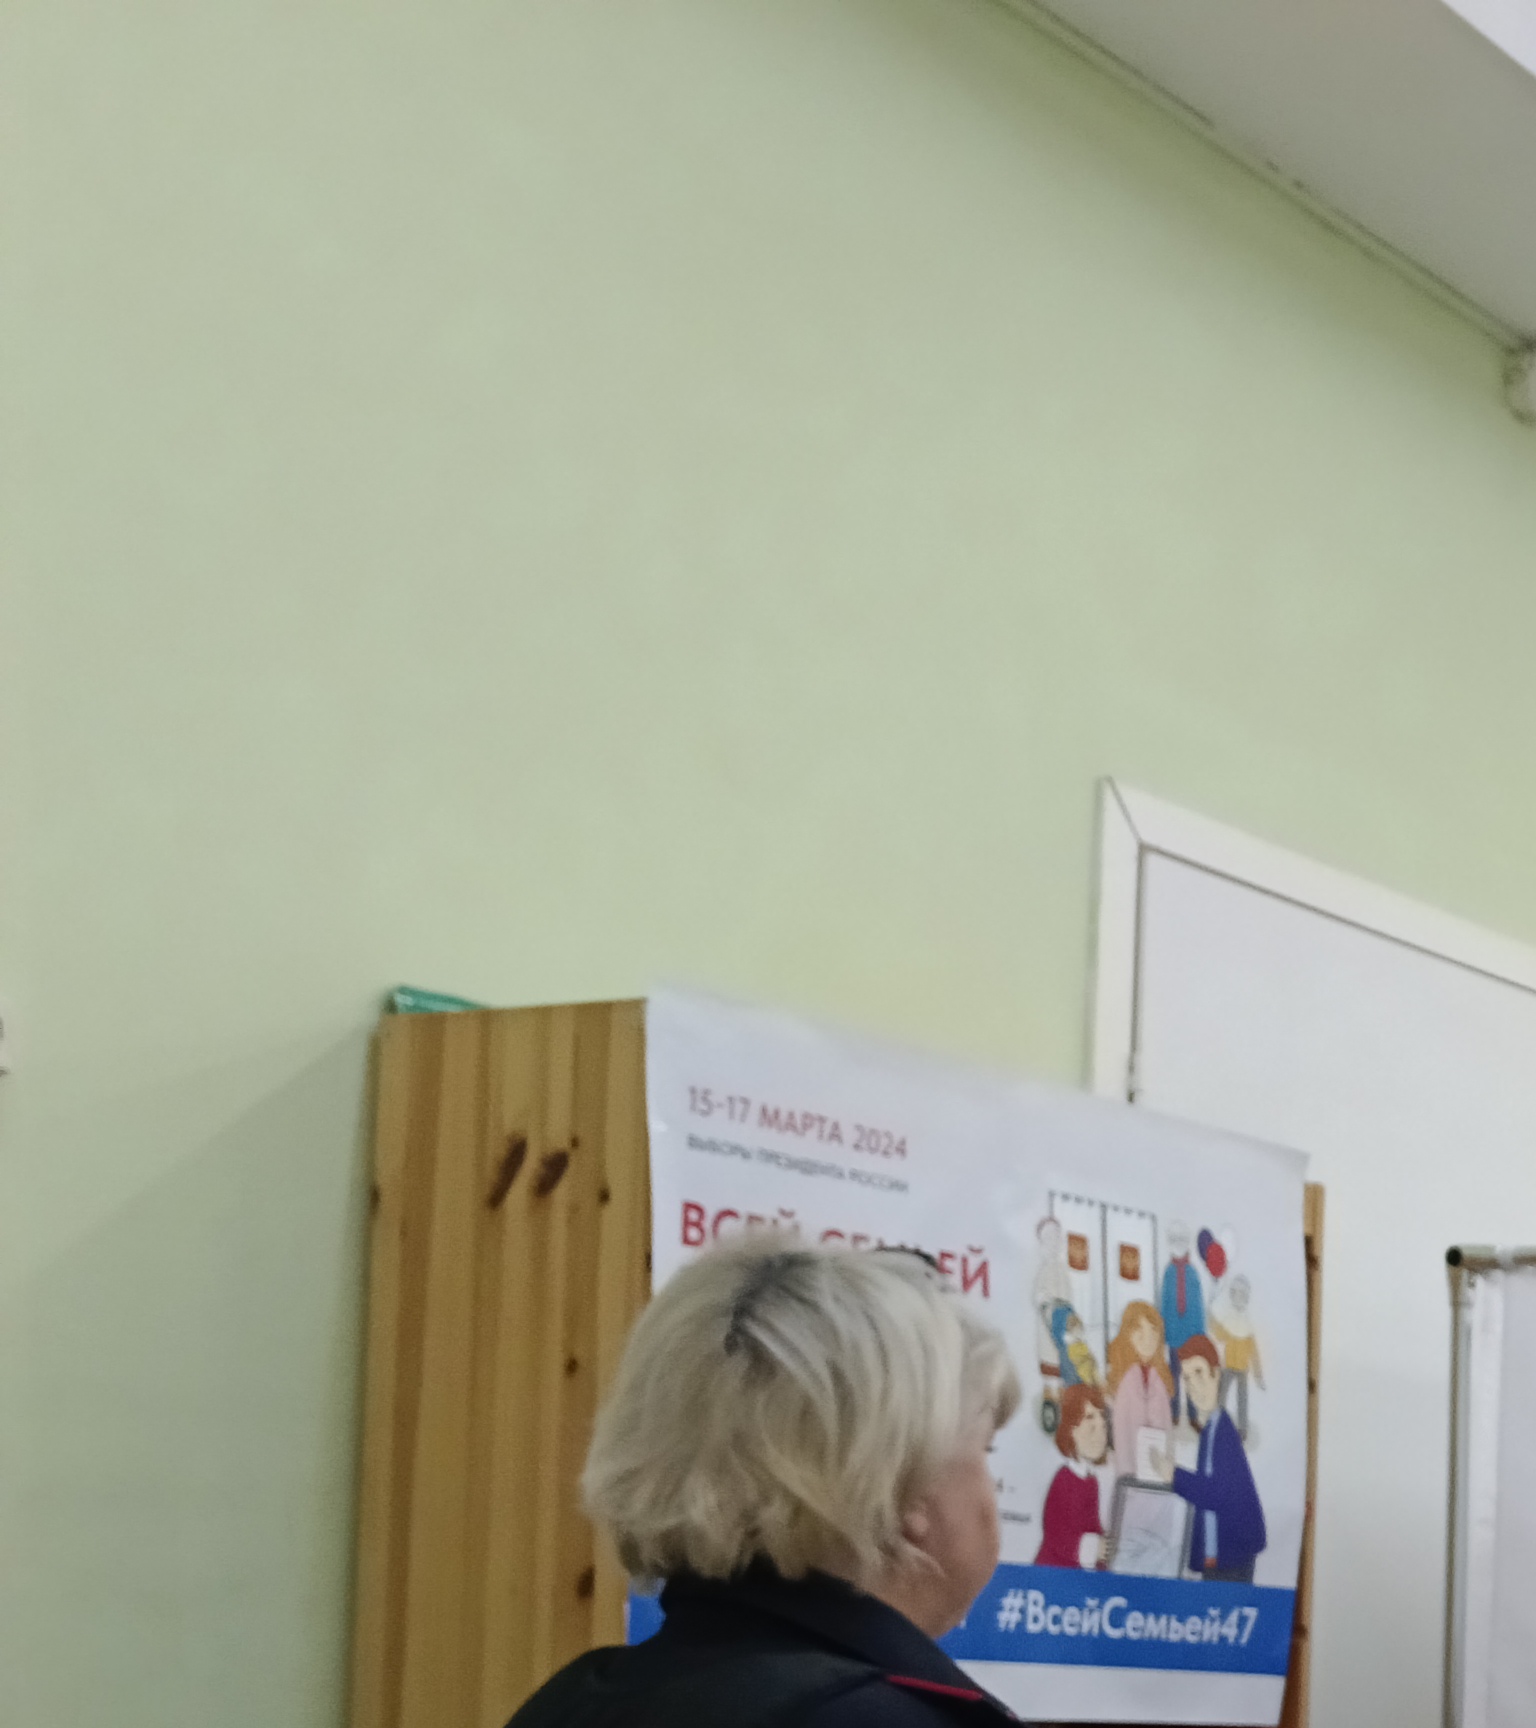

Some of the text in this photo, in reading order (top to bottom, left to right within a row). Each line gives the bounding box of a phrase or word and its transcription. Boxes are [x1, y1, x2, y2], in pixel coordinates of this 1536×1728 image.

[688, 1085, 908, 1159] 15-17 МАРТА 2024
[997, 1588, 1259, 1647] #ВсейСемьей47
